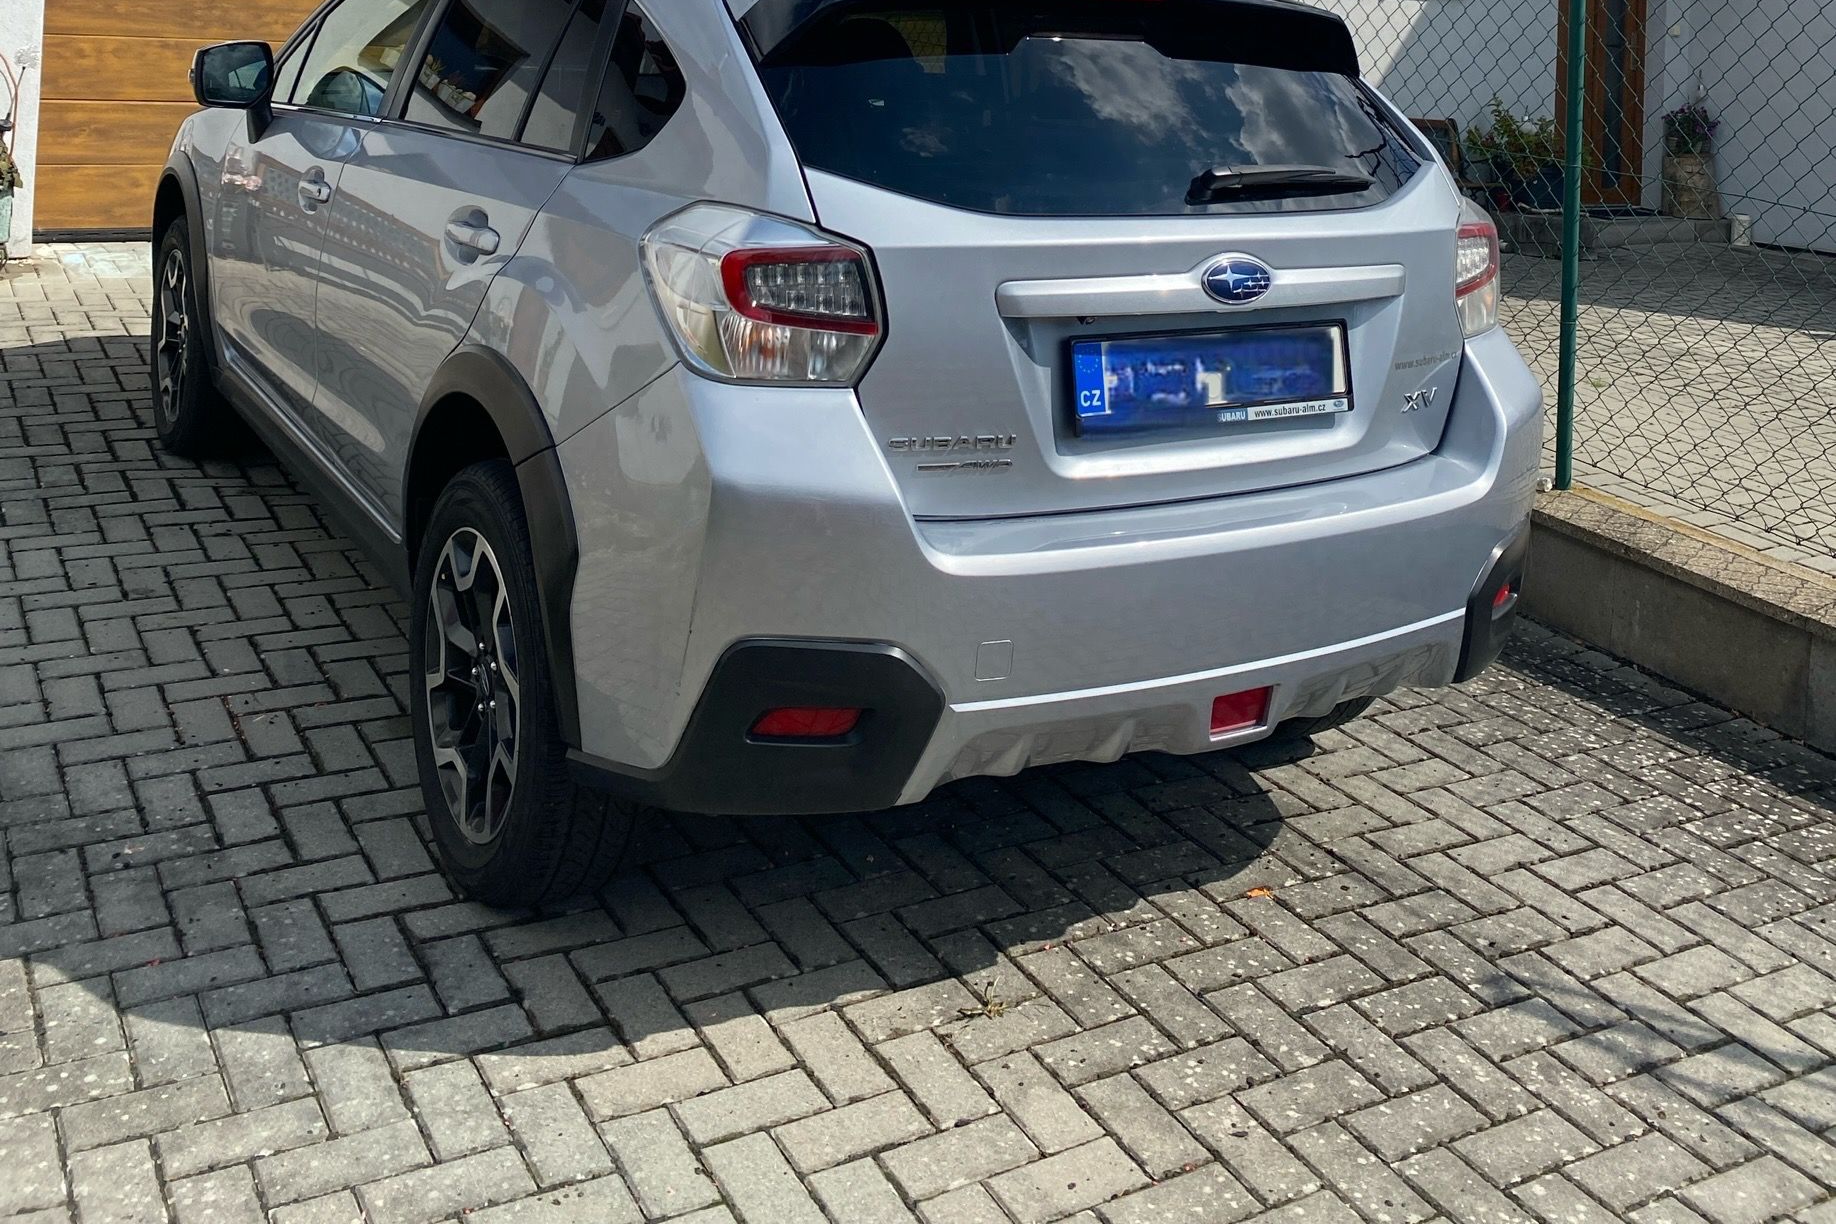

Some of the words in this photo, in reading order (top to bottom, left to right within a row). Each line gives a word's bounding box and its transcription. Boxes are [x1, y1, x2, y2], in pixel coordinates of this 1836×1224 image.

[1080, 389, 1102, 407] CZ
[1401, 387, 1438, 413] XV
[1254, 403, 1327, 418] www.subaru-alm.cz
[888, 434, 1017, 452] SUBARU
